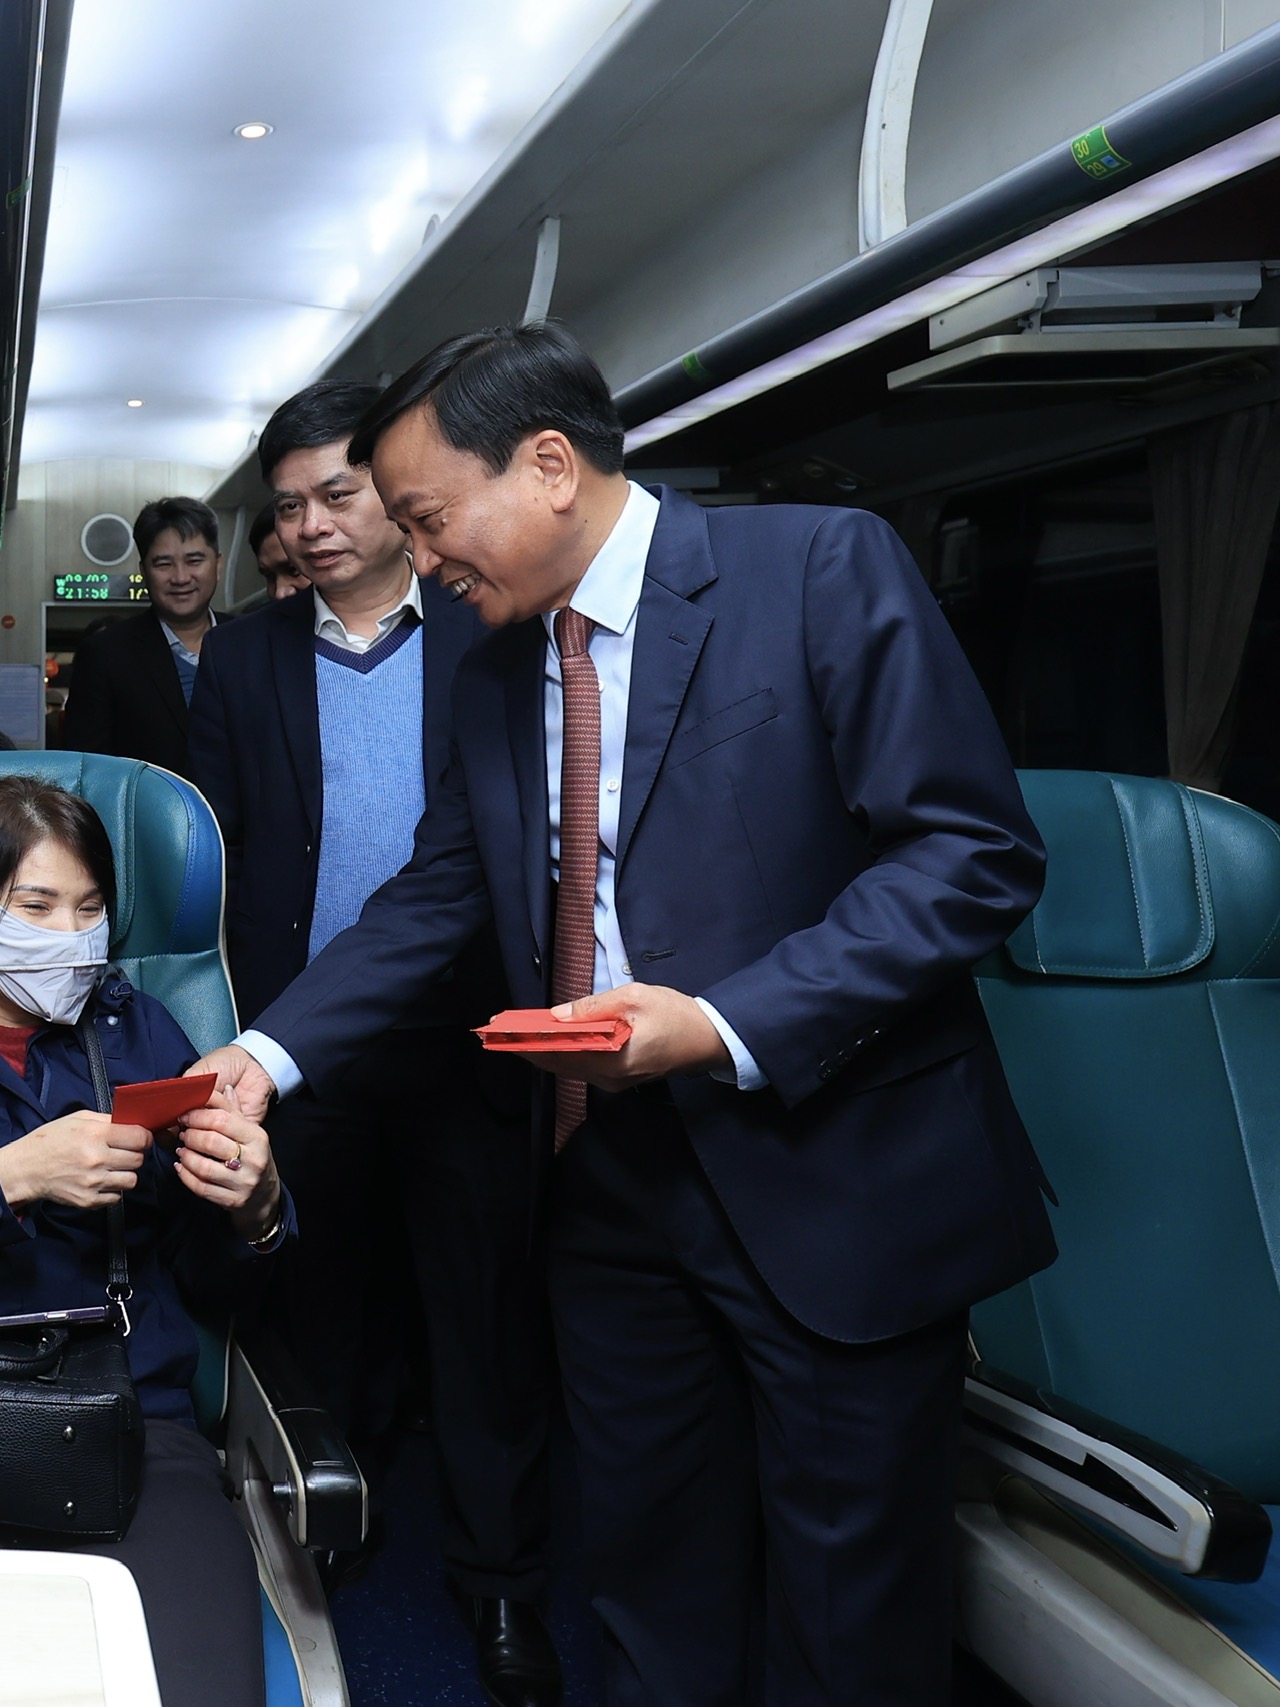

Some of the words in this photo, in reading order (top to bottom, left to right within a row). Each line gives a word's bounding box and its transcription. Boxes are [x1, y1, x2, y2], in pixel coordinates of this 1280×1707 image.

[1074, 139, 1090, 158] 30
[1087, 162, 1107, 176] 29
[65, 588, 109, 600] 21:58
